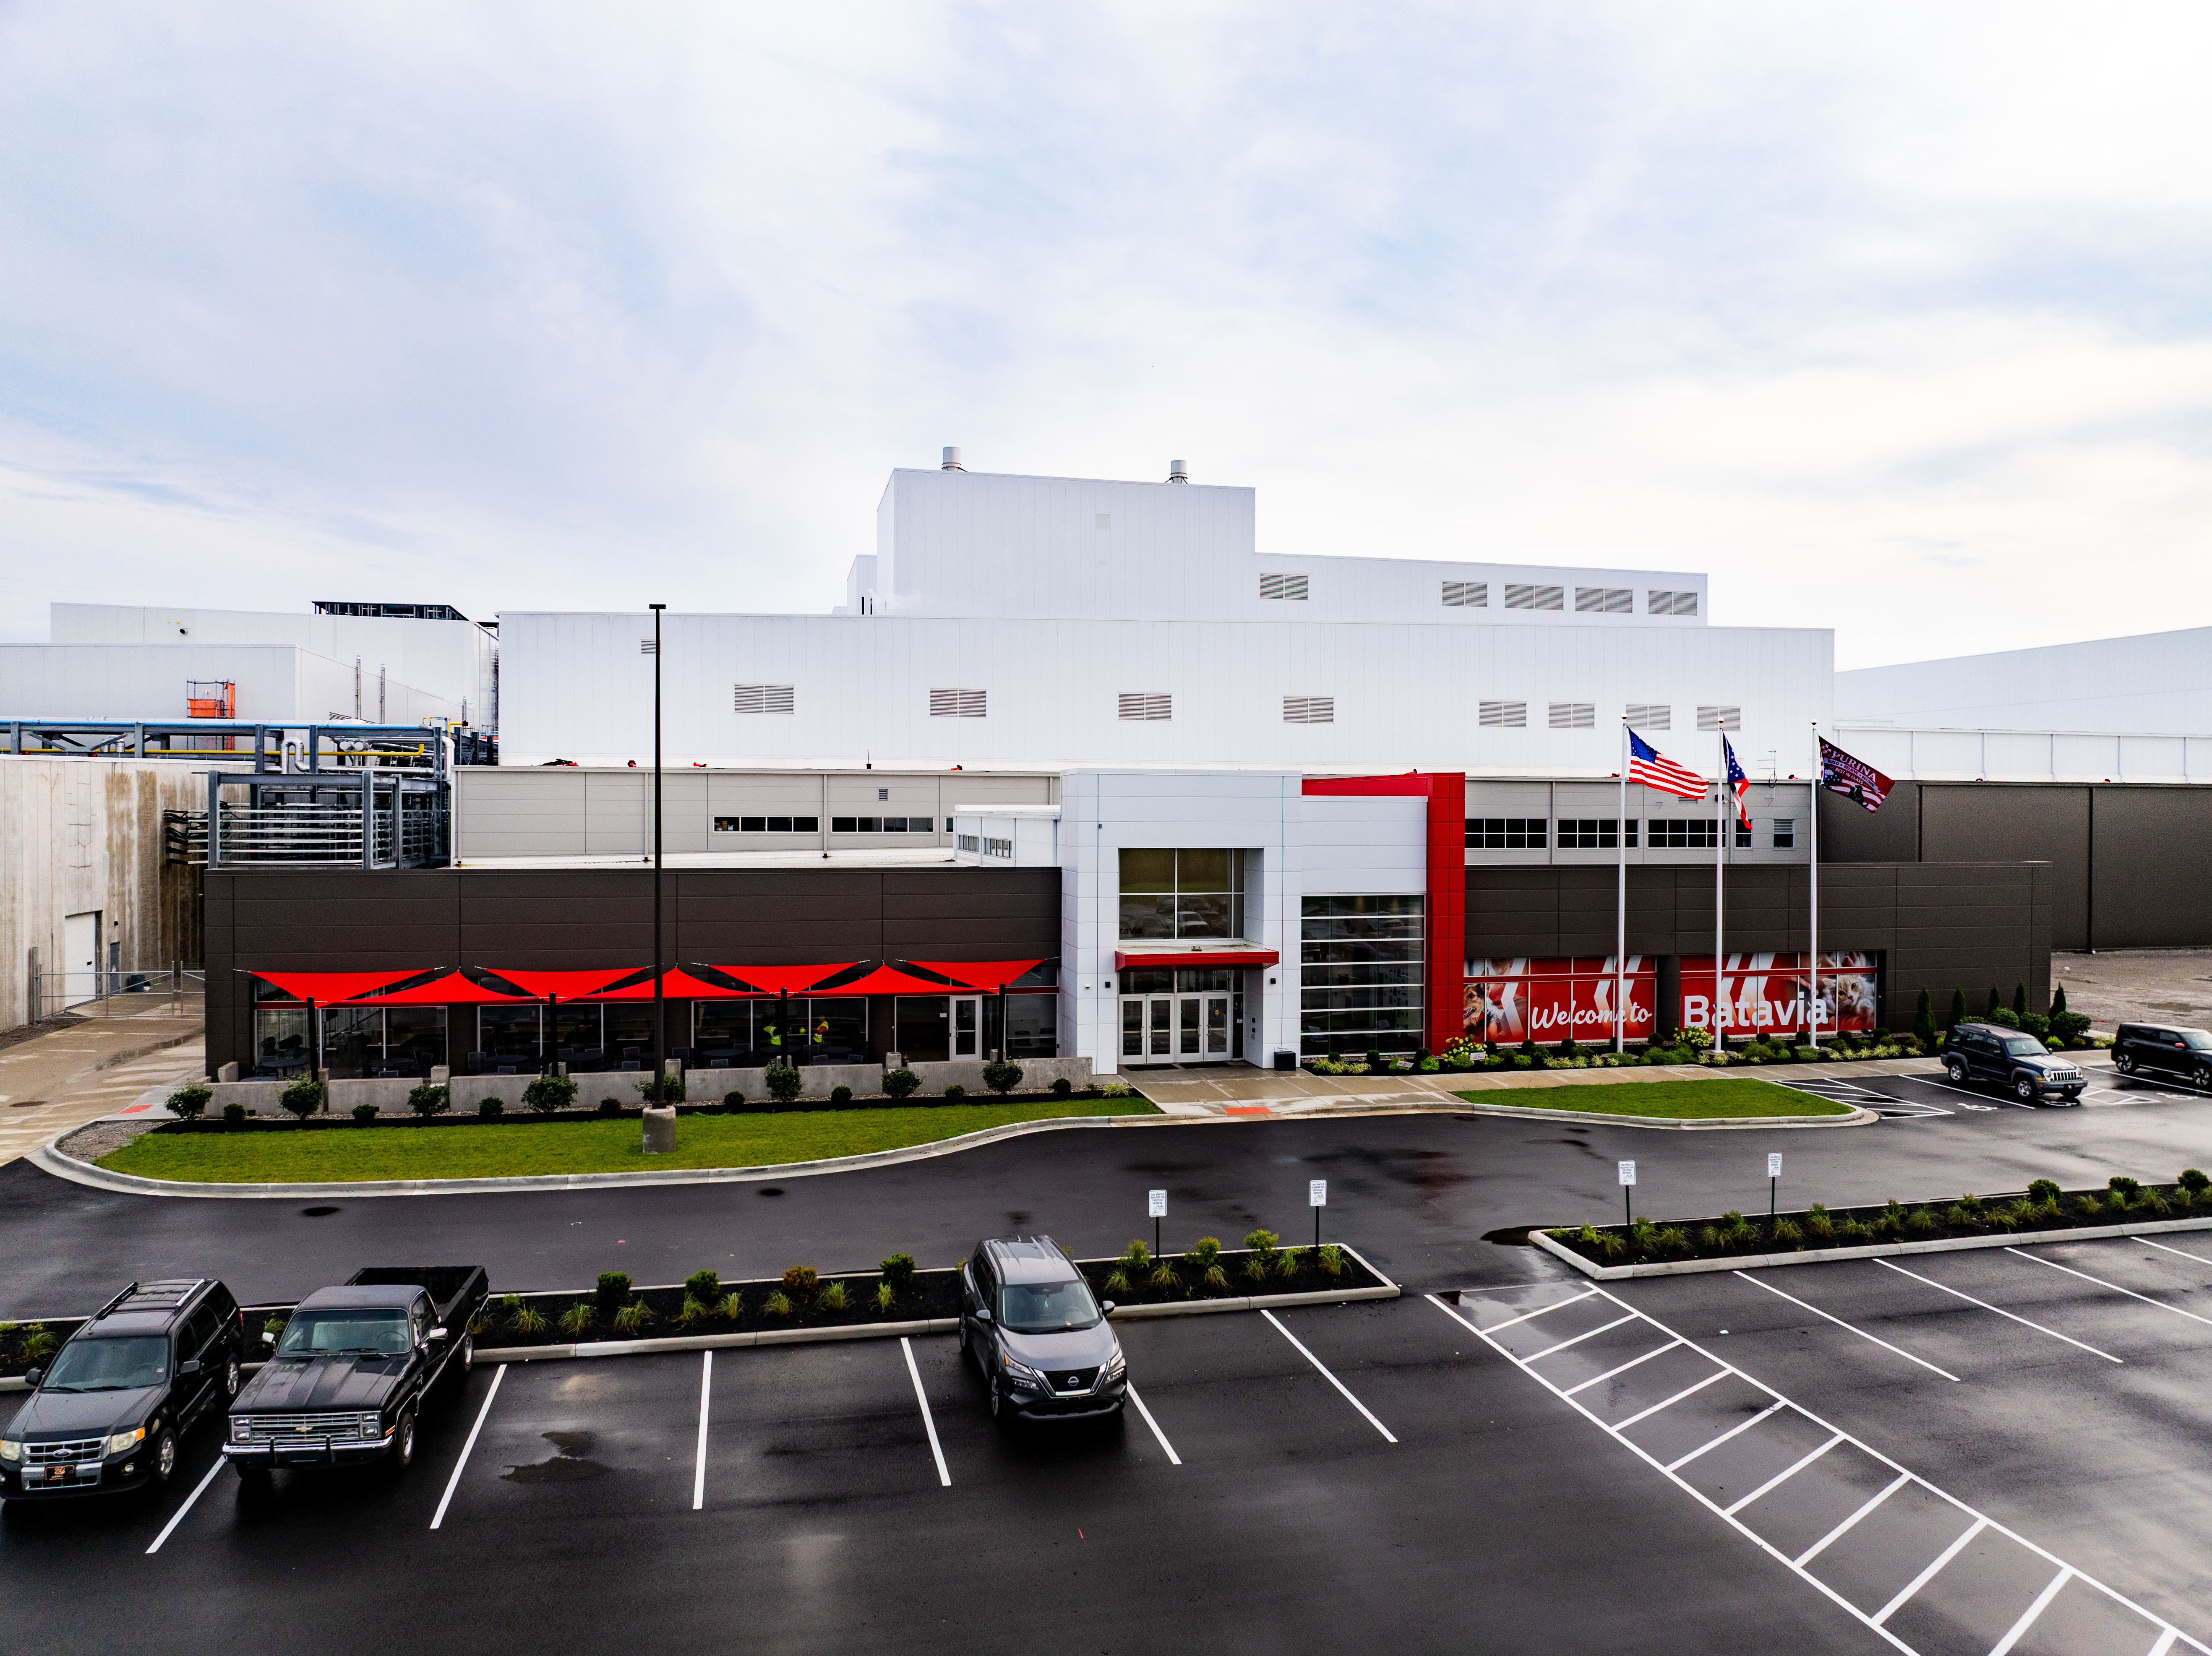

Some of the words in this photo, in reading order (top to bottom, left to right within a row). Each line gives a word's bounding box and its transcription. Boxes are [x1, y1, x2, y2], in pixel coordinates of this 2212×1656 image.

[1831, 750, 1876, 783] PURINA
[1843, 765, 1859, 776] BELIEVE
[1861, 774, 1875, 787] BECOME
[1851, 774, 1864, 784] CLASS
[1630, 1002, 1653, 1023] to
[1684, 991, 1829, 1028] Batavia
